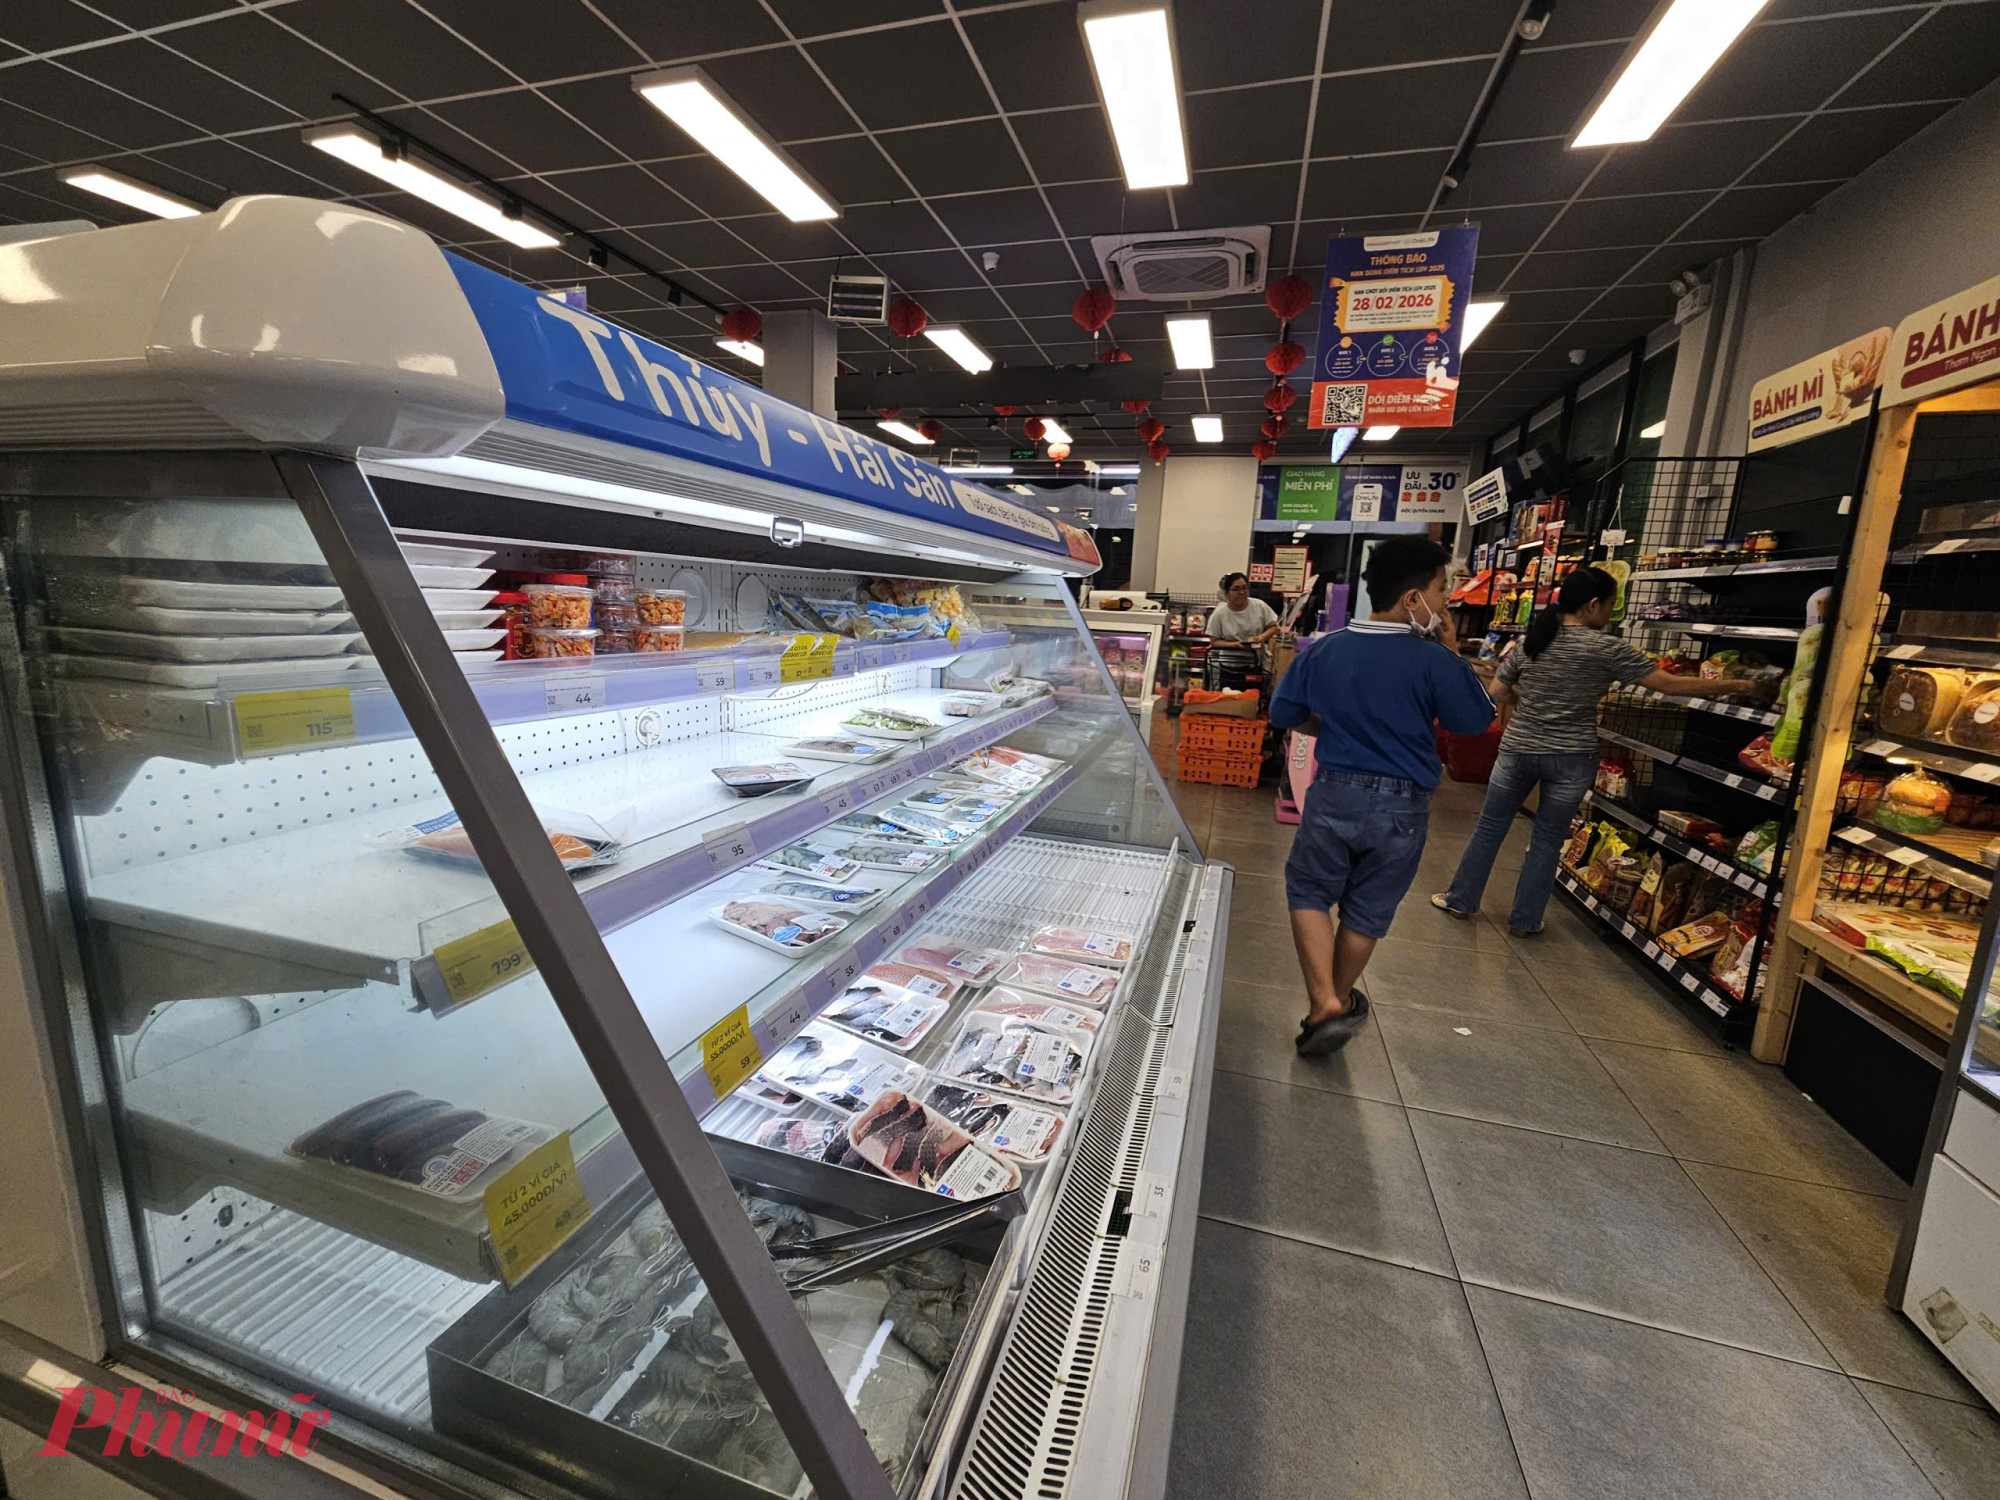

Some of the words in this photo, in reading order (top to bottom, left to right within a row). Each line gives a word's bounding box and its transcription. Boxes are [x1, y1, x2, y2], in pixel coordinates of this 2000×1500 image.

[1370, 254, 1404, 266] THÔNG
[1406, 252, 1427, 263] BÁO
[1352, 294, 1434, 311] 28/02/2026
[1904, 298, 2000, 368] BÁNH
[1753, 384, 1797, 421] BÁNH
[1802, 368, 1824, 404] MÌ
[537, 296, 772, 467] Thủy
[787, 428, 808, 445] -
[808, 412, 895, 490] Hải
[887, 446, 955, 509] Sản
[1406, 471, 1420, 480] ƯU
[1285, 478, 1312, 491] MIỄN
[1314, 479, 1334, 490] PHÍ
[1404, 481, 1422, 491] ĐÃI
[715, 677, 725, 686] 59
[764, 671, 773, 680] 79
[575, 693, 591, 704] 44
[306, 722, 333, 737] 115
[838, 799, 847, 809] 45
[731, 844, 744, 857] 95
[845, 965, 854, 977] 55
[789, 1010, 800, 1024] 44
[740, 1056, 750, 1068] 59
[1173, 1076, 1182, 1084] 59
[501, 1188, 518, 1209] TỪ
[520, 1185, 528, 1196] 2
[542, 1159, 561, 1179] GIÁ
[1153, 1186, 1164, 1197] 33
[555, 1210, 571, 1229] 49
[1139, 1259, 1150, 1273] 65
